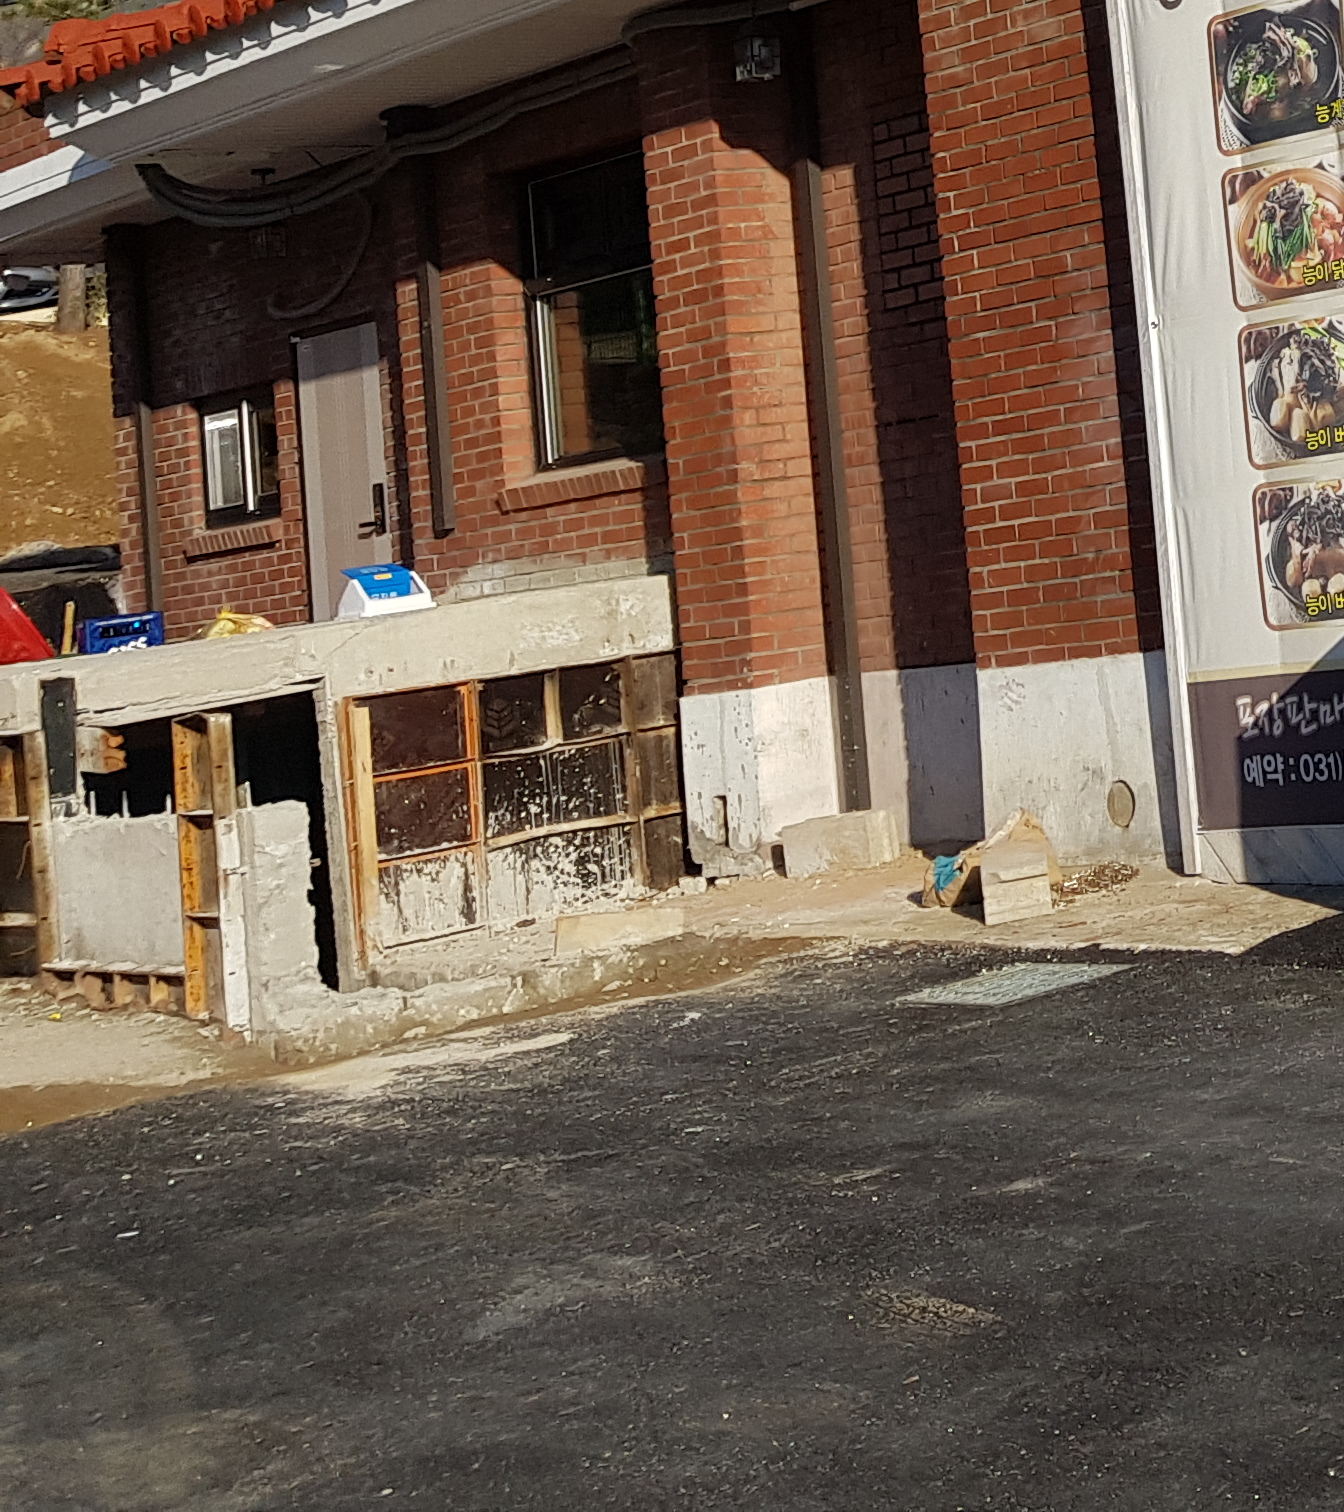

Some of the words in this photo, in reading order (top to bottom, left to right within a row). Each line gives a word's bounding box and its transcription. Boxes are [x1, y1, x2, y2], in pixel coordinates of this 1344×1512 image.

[1302, 263, 1329, 286] 능이
[1305, 426, 1332, 451] 능이
[1305, 592, 1332, 616] 능이
